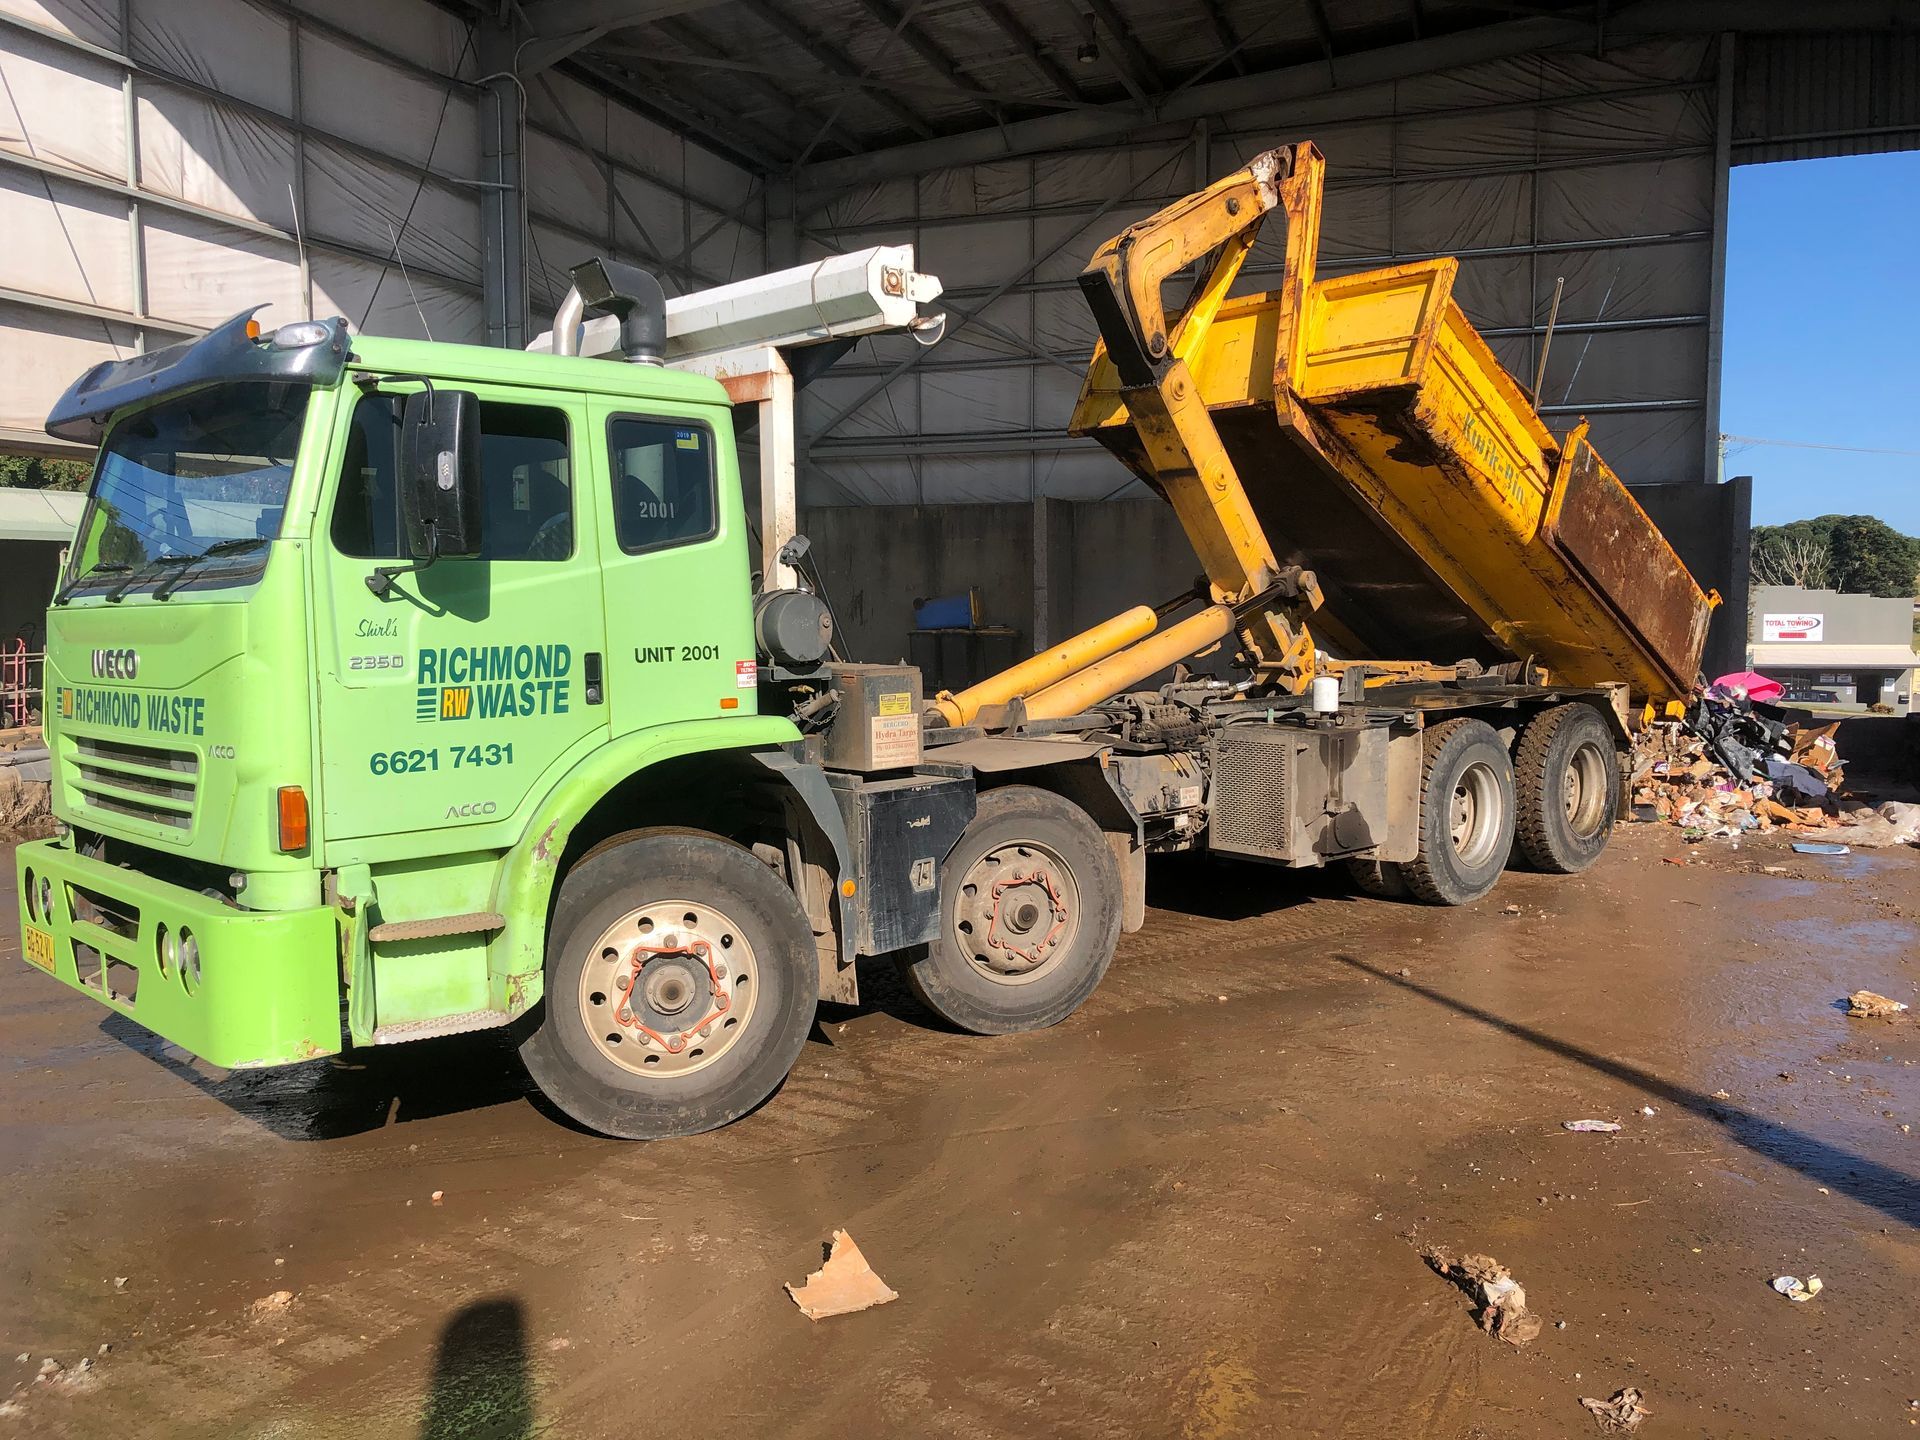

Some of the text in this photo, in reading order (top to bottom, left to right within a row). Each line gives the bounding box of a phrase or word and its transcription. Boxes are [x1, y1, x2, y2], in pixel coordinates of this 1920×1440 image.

[639, 501, 675, 519] 2001
[355, 617, 398, 638] Shirl's
[91, 648, 140, 680] IVECO
[348, 654, 404, 670] 2350
[417, 643, 572, 685] RICHMOND
[634, 645, 720, 664] UNIT 2001
[442, 679, 571, 719] RW WASTE
[75, 688, 141, 729] RICHMOND
[147, 694, 205, 736] WASTE
[875, 730, 897, 741] Hydra
[207, 744, 236, 760] ACCO
[369, 743, 513, 776] 6621 7431
[444, 801, 497, 820] ACCO
